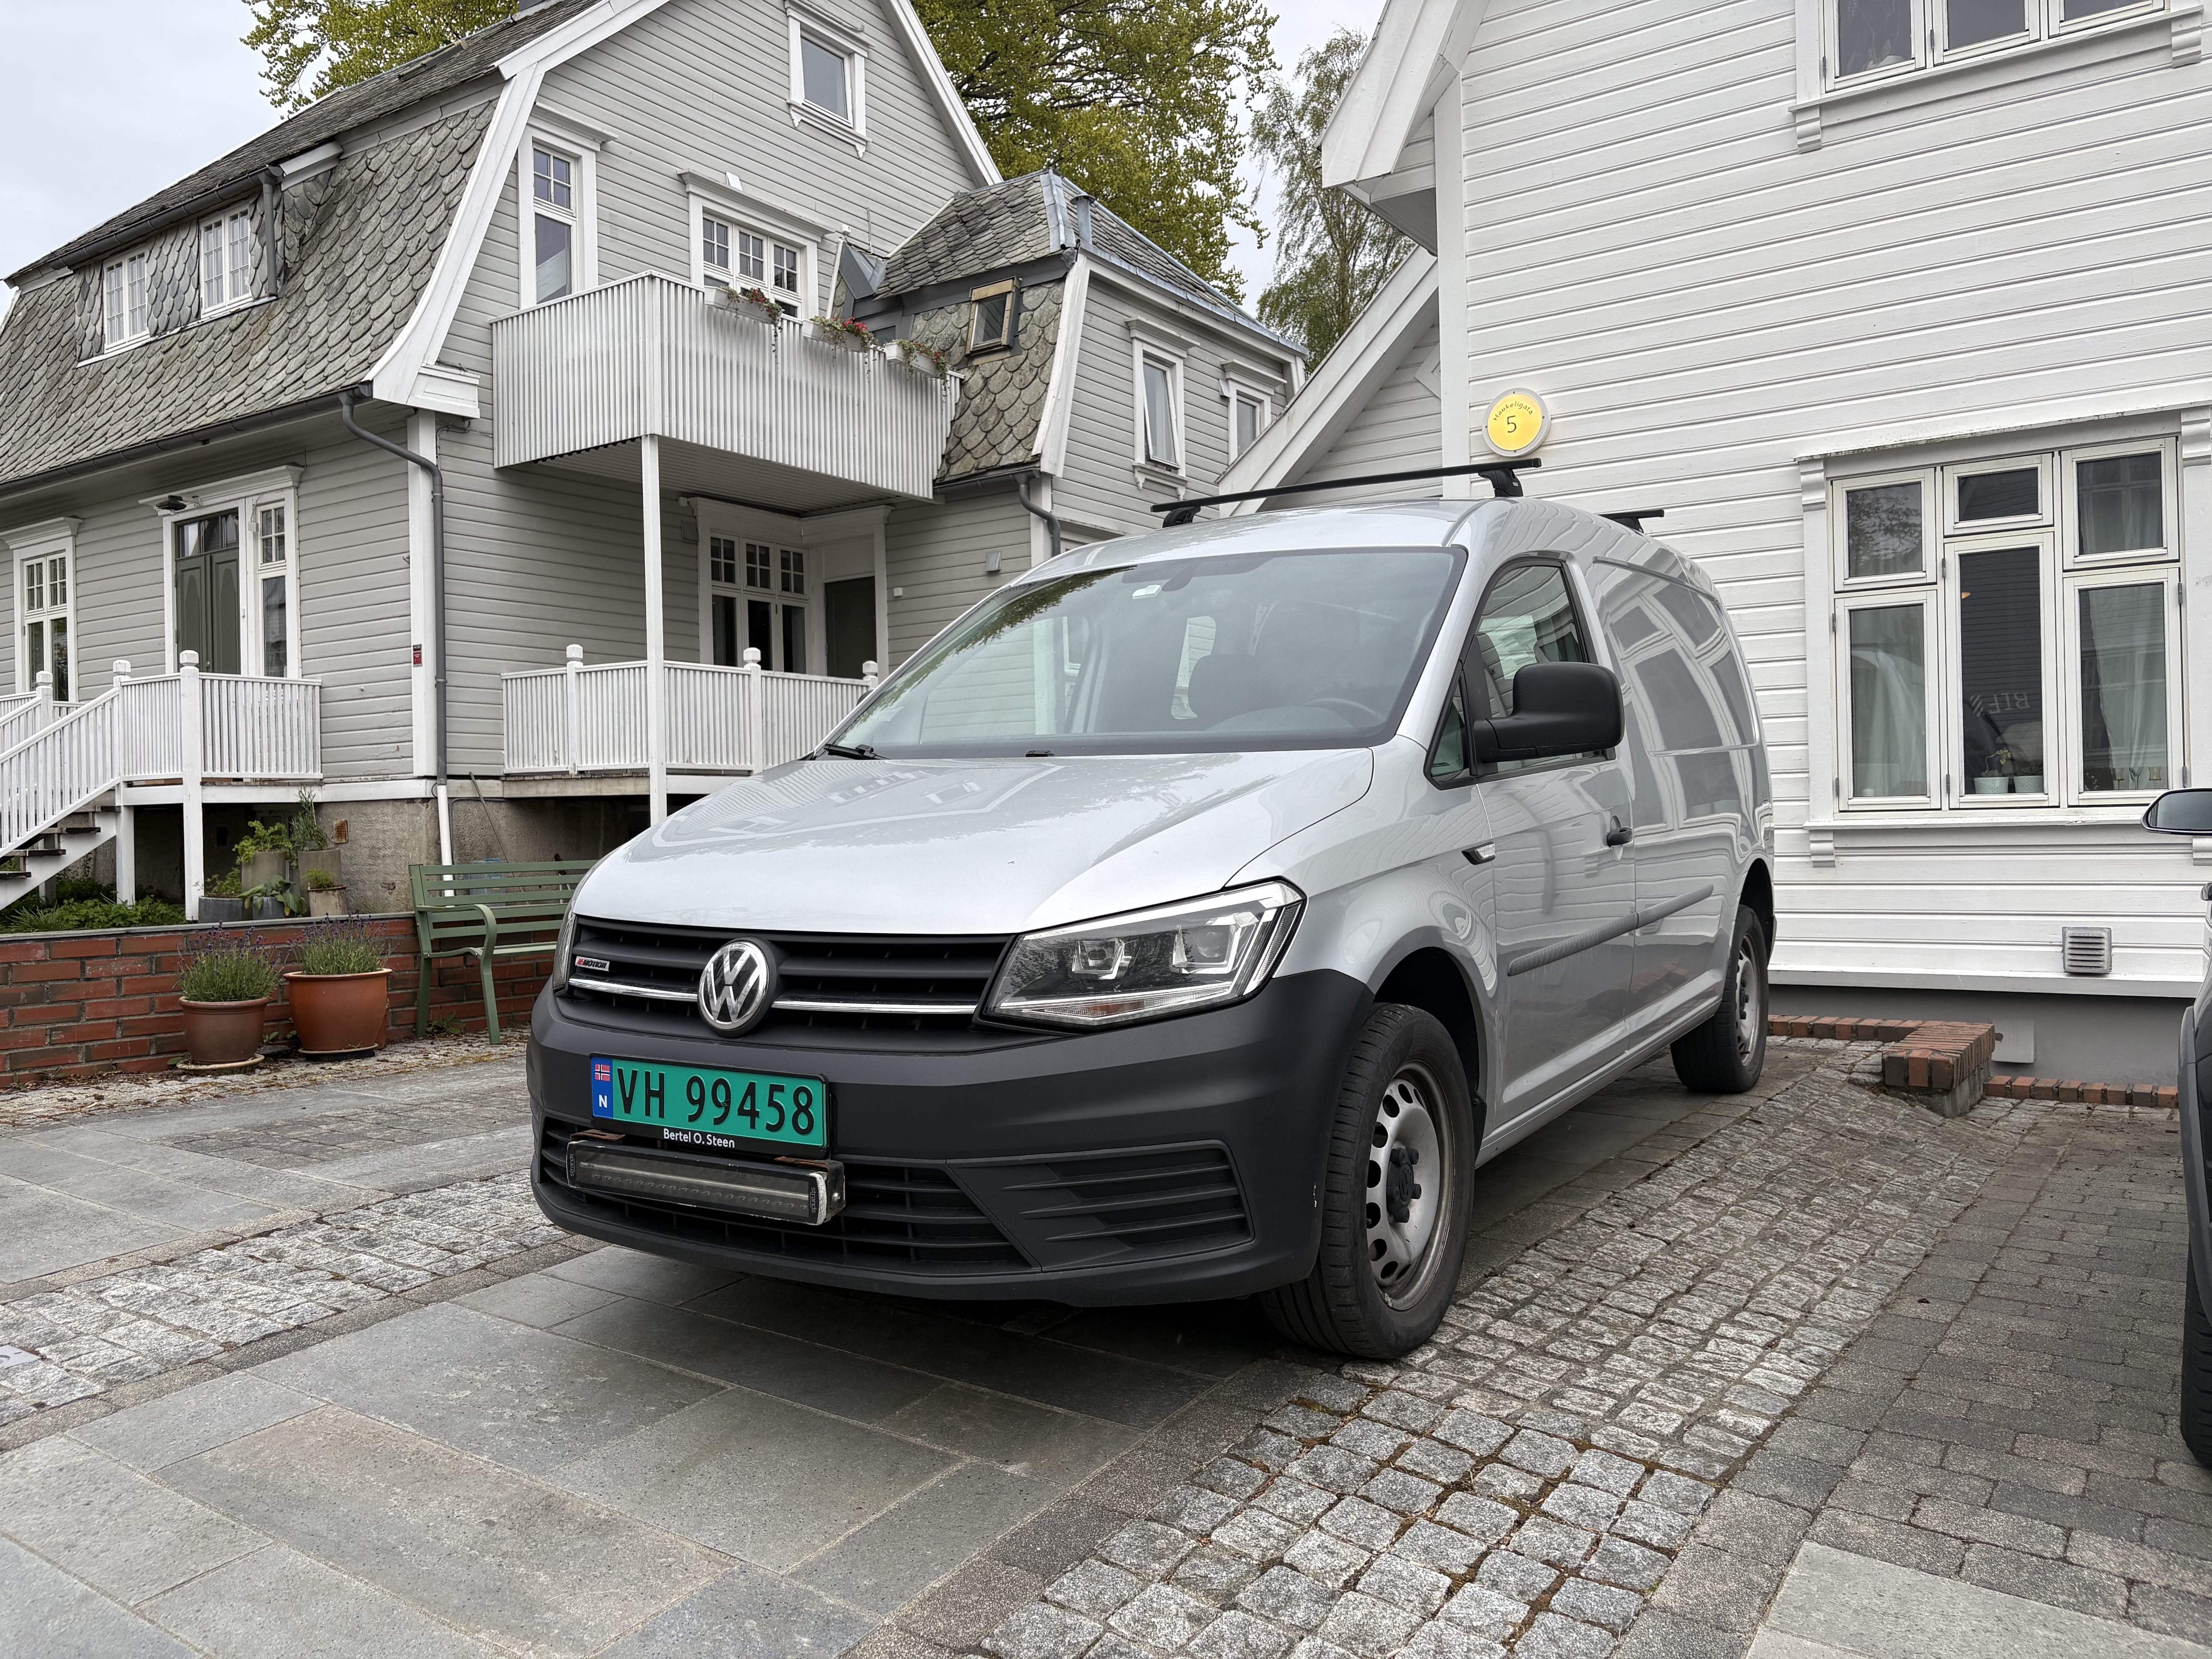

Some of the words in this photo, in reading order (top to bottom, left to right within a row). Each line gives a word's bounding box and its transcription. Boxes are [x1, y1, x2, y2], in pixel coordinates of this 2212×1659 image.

[1493, 402, 1533, 421] Haukeligata
[1507, 415, 1517, 433] 5
[599, 1094, 608, 1108] N
[617, 1068, 665, 1119] VH
[686, 1075, 815, 1135] 99458
[663, 1128, 691, 1142] Bertel
[693, 1132, 704, 1144] O.
[707, 1134, 735, 1148] Steen
